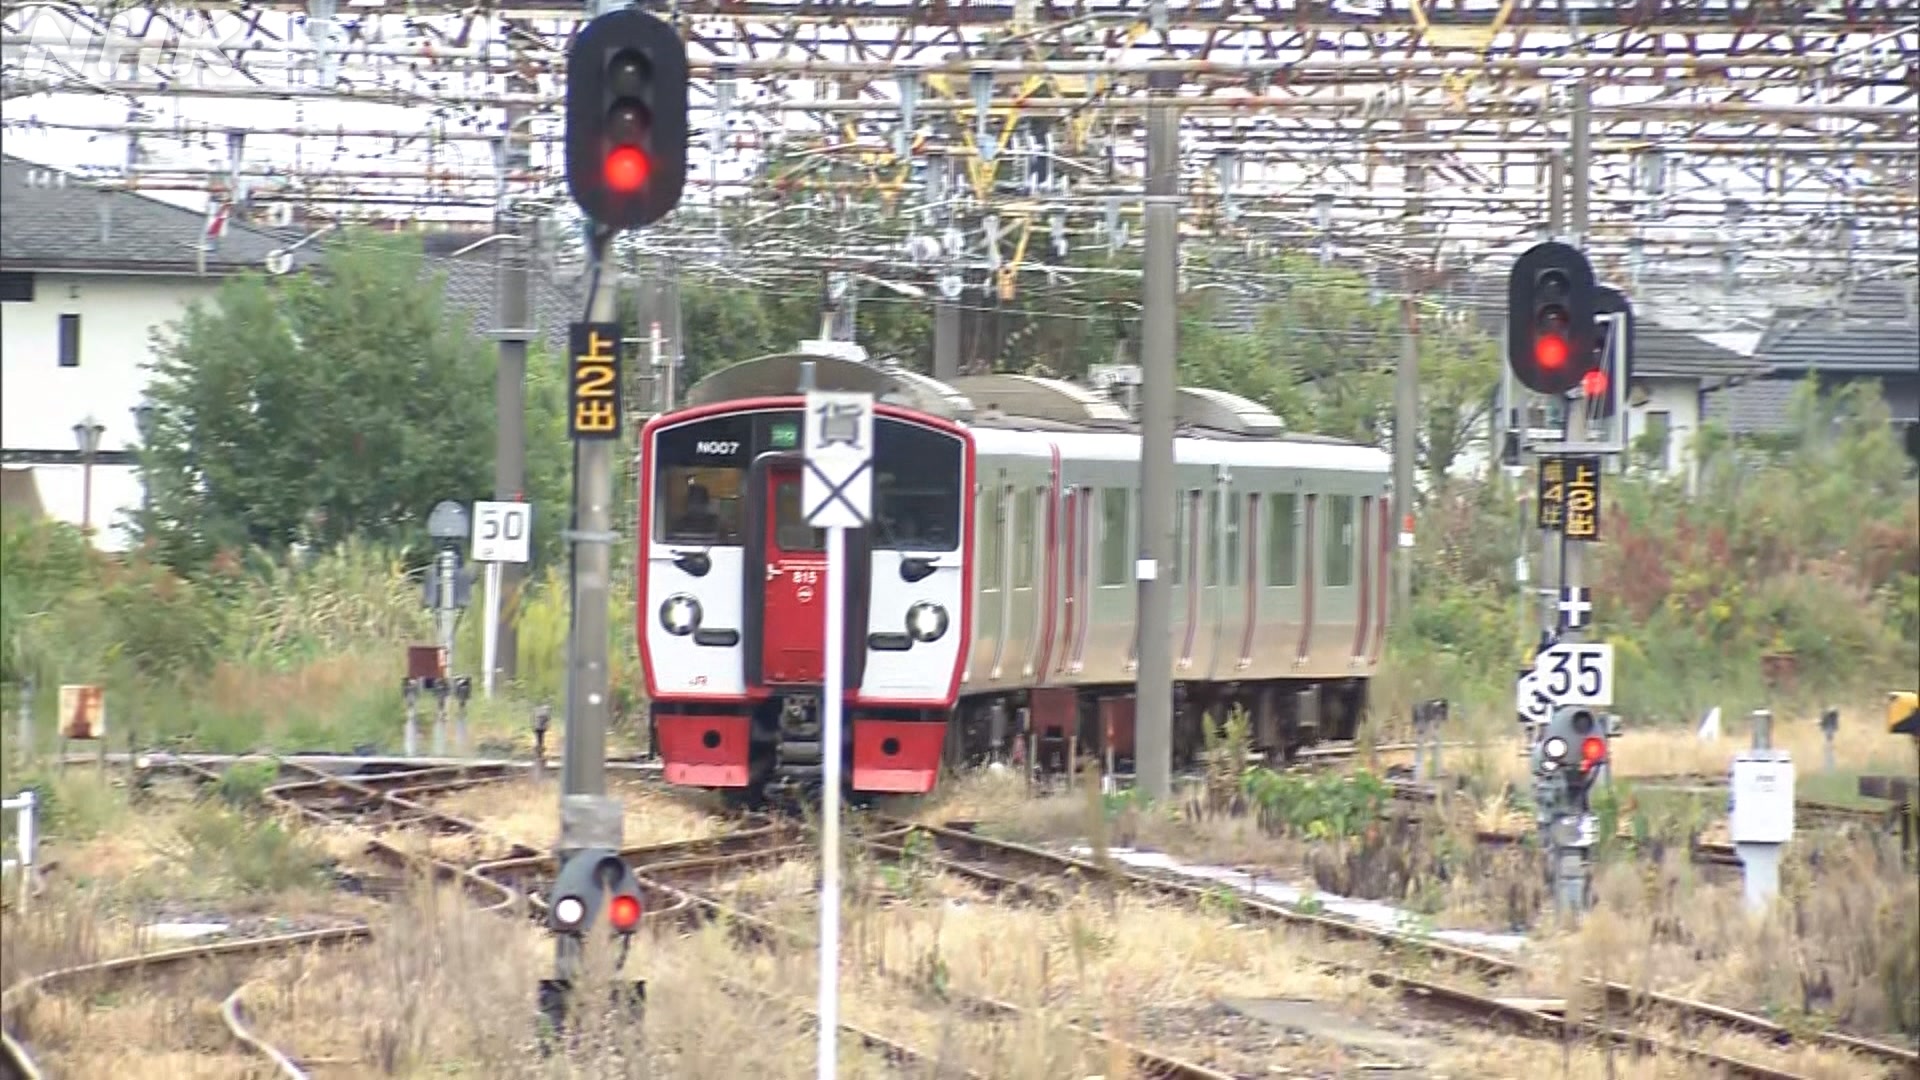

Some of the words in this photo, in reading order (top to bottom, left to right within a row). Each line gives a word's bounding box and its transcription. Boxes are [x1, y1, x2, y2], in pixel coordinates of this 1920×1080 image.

[815, 402, 865, 450] 貨
[696, 441, 740, 455] N007
[482, 509, 524, 540] 50
[793, 571, 817, 584] 815
[1547, 651, 1602, 696] 35
